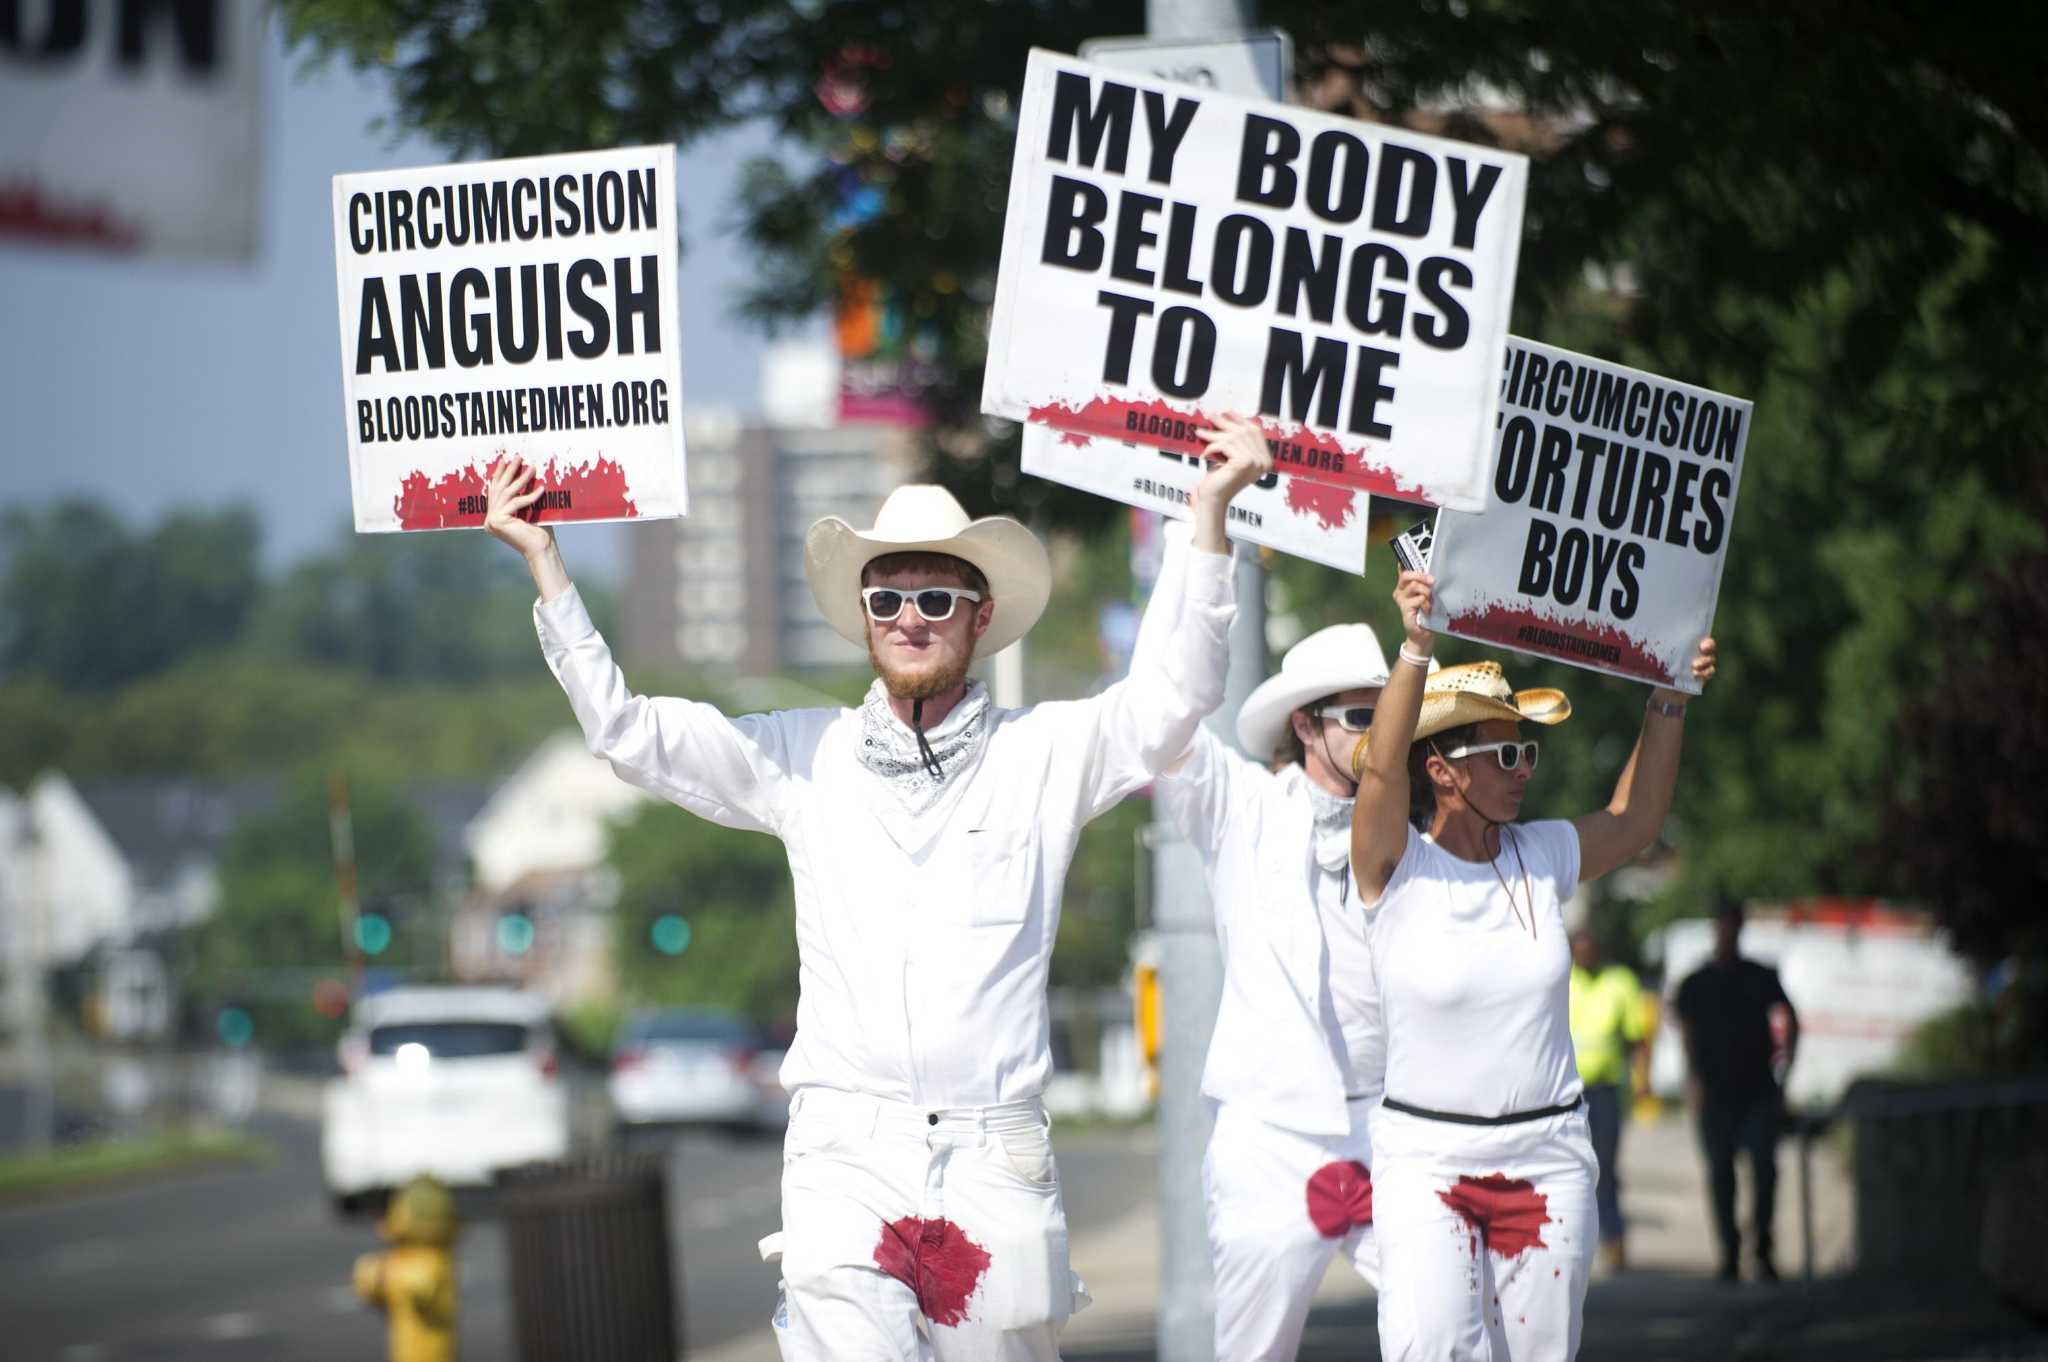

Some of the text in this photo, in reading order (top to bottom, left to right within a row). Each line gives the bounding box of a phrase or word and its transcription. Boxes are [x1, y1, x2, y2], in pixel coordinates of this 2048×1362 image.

[349, 168, 658, 255] CIRCUMCISION
[1046, 70, 1504, 251] MY BODY
[355, 255, 662, 375] ANGUISH
[1041, 174, 1474, 351] BELONGS
[357, 378, 669, 444] BLOODSTAINEDMEN.ORG
[1098, 290, 1401, 441] TO ME
[1125, 409, 1345, 474] BLOODSMEN.ORG
[1495, 411, 1732, 555] ORTURES
[1132, 477, 1263, 528] #BLOODSDMEN
[1517, 517, 1646, 621] BOYS
